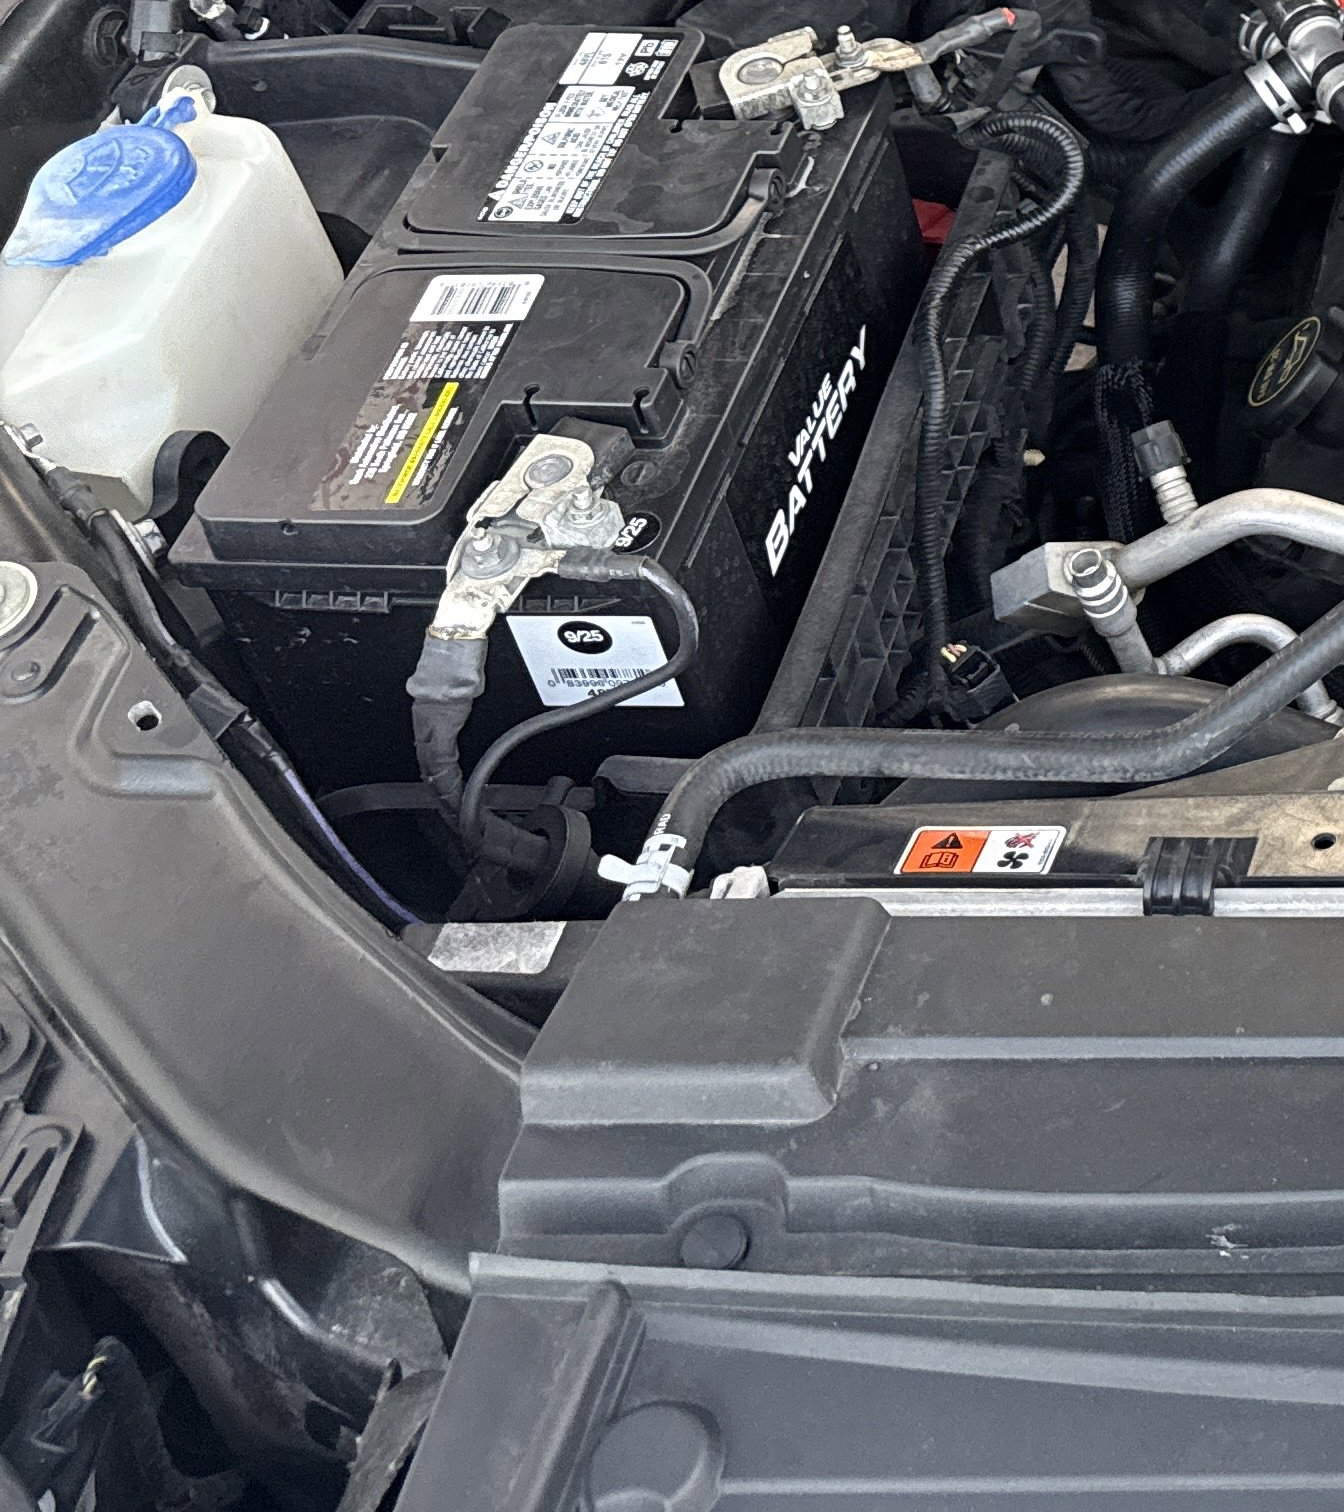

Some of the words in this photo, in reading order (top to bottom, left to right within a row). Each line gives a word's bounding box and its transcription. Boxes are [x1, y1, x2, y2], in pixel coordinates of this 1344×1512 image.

[765, 323, 867, 578] BATTERY
[788, 371, 833, 467] VALUE
[615, 516, 648, 548] 9/25
[563, 629, 605, 644] 9/25
